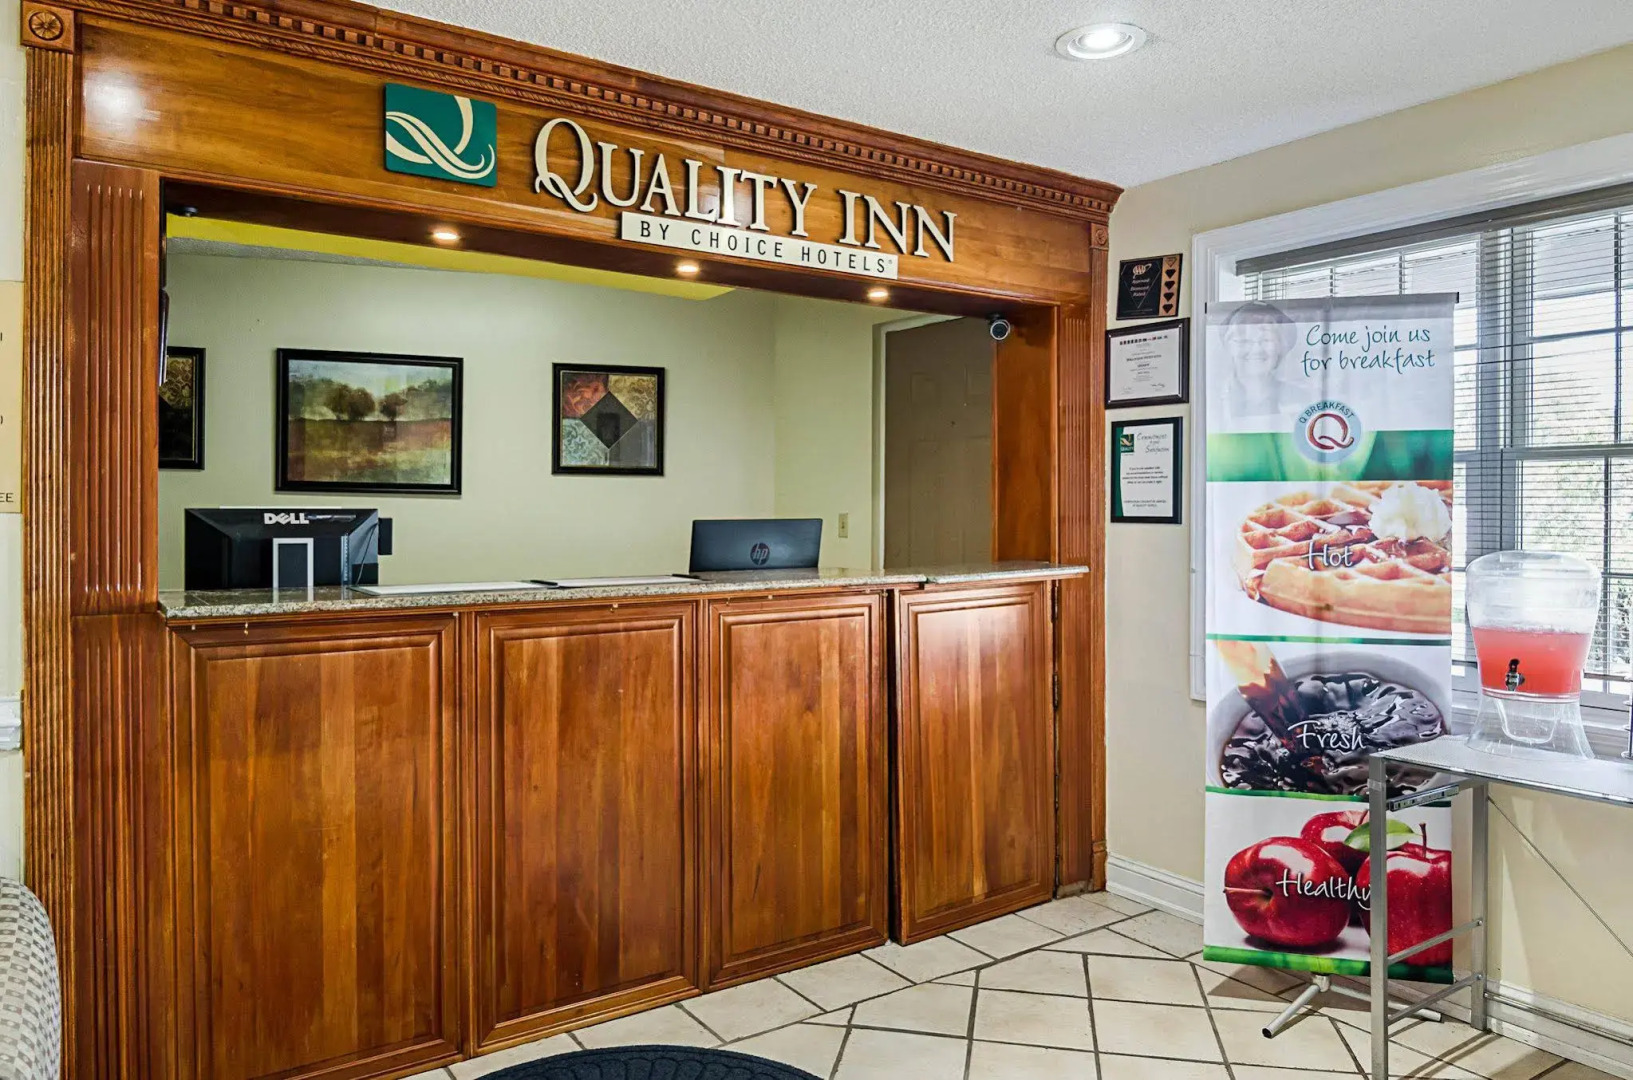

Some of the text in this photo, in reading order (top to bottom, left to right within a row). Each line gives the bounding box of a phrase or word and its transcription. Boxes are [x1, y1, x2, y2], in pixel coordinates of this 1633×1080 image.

[534, 117, 957, 262] QUALITY INN
[640, 221, 886, 273] BY CHOICE HOTELS
[1305, 324, 1431, 352] Come join us
[1300, 347, 1436, 377] for breakfast
[1304, 401, 1355, 419] BREAKFAST
[263, 512, 310, 525] DELL
[752, 542, 768, 566] hp
[1300, 539, 1353, 570] Hot
[1287, 719, 1367, 750] Fresh
[1275, 868, 1371, 911] Healthy
